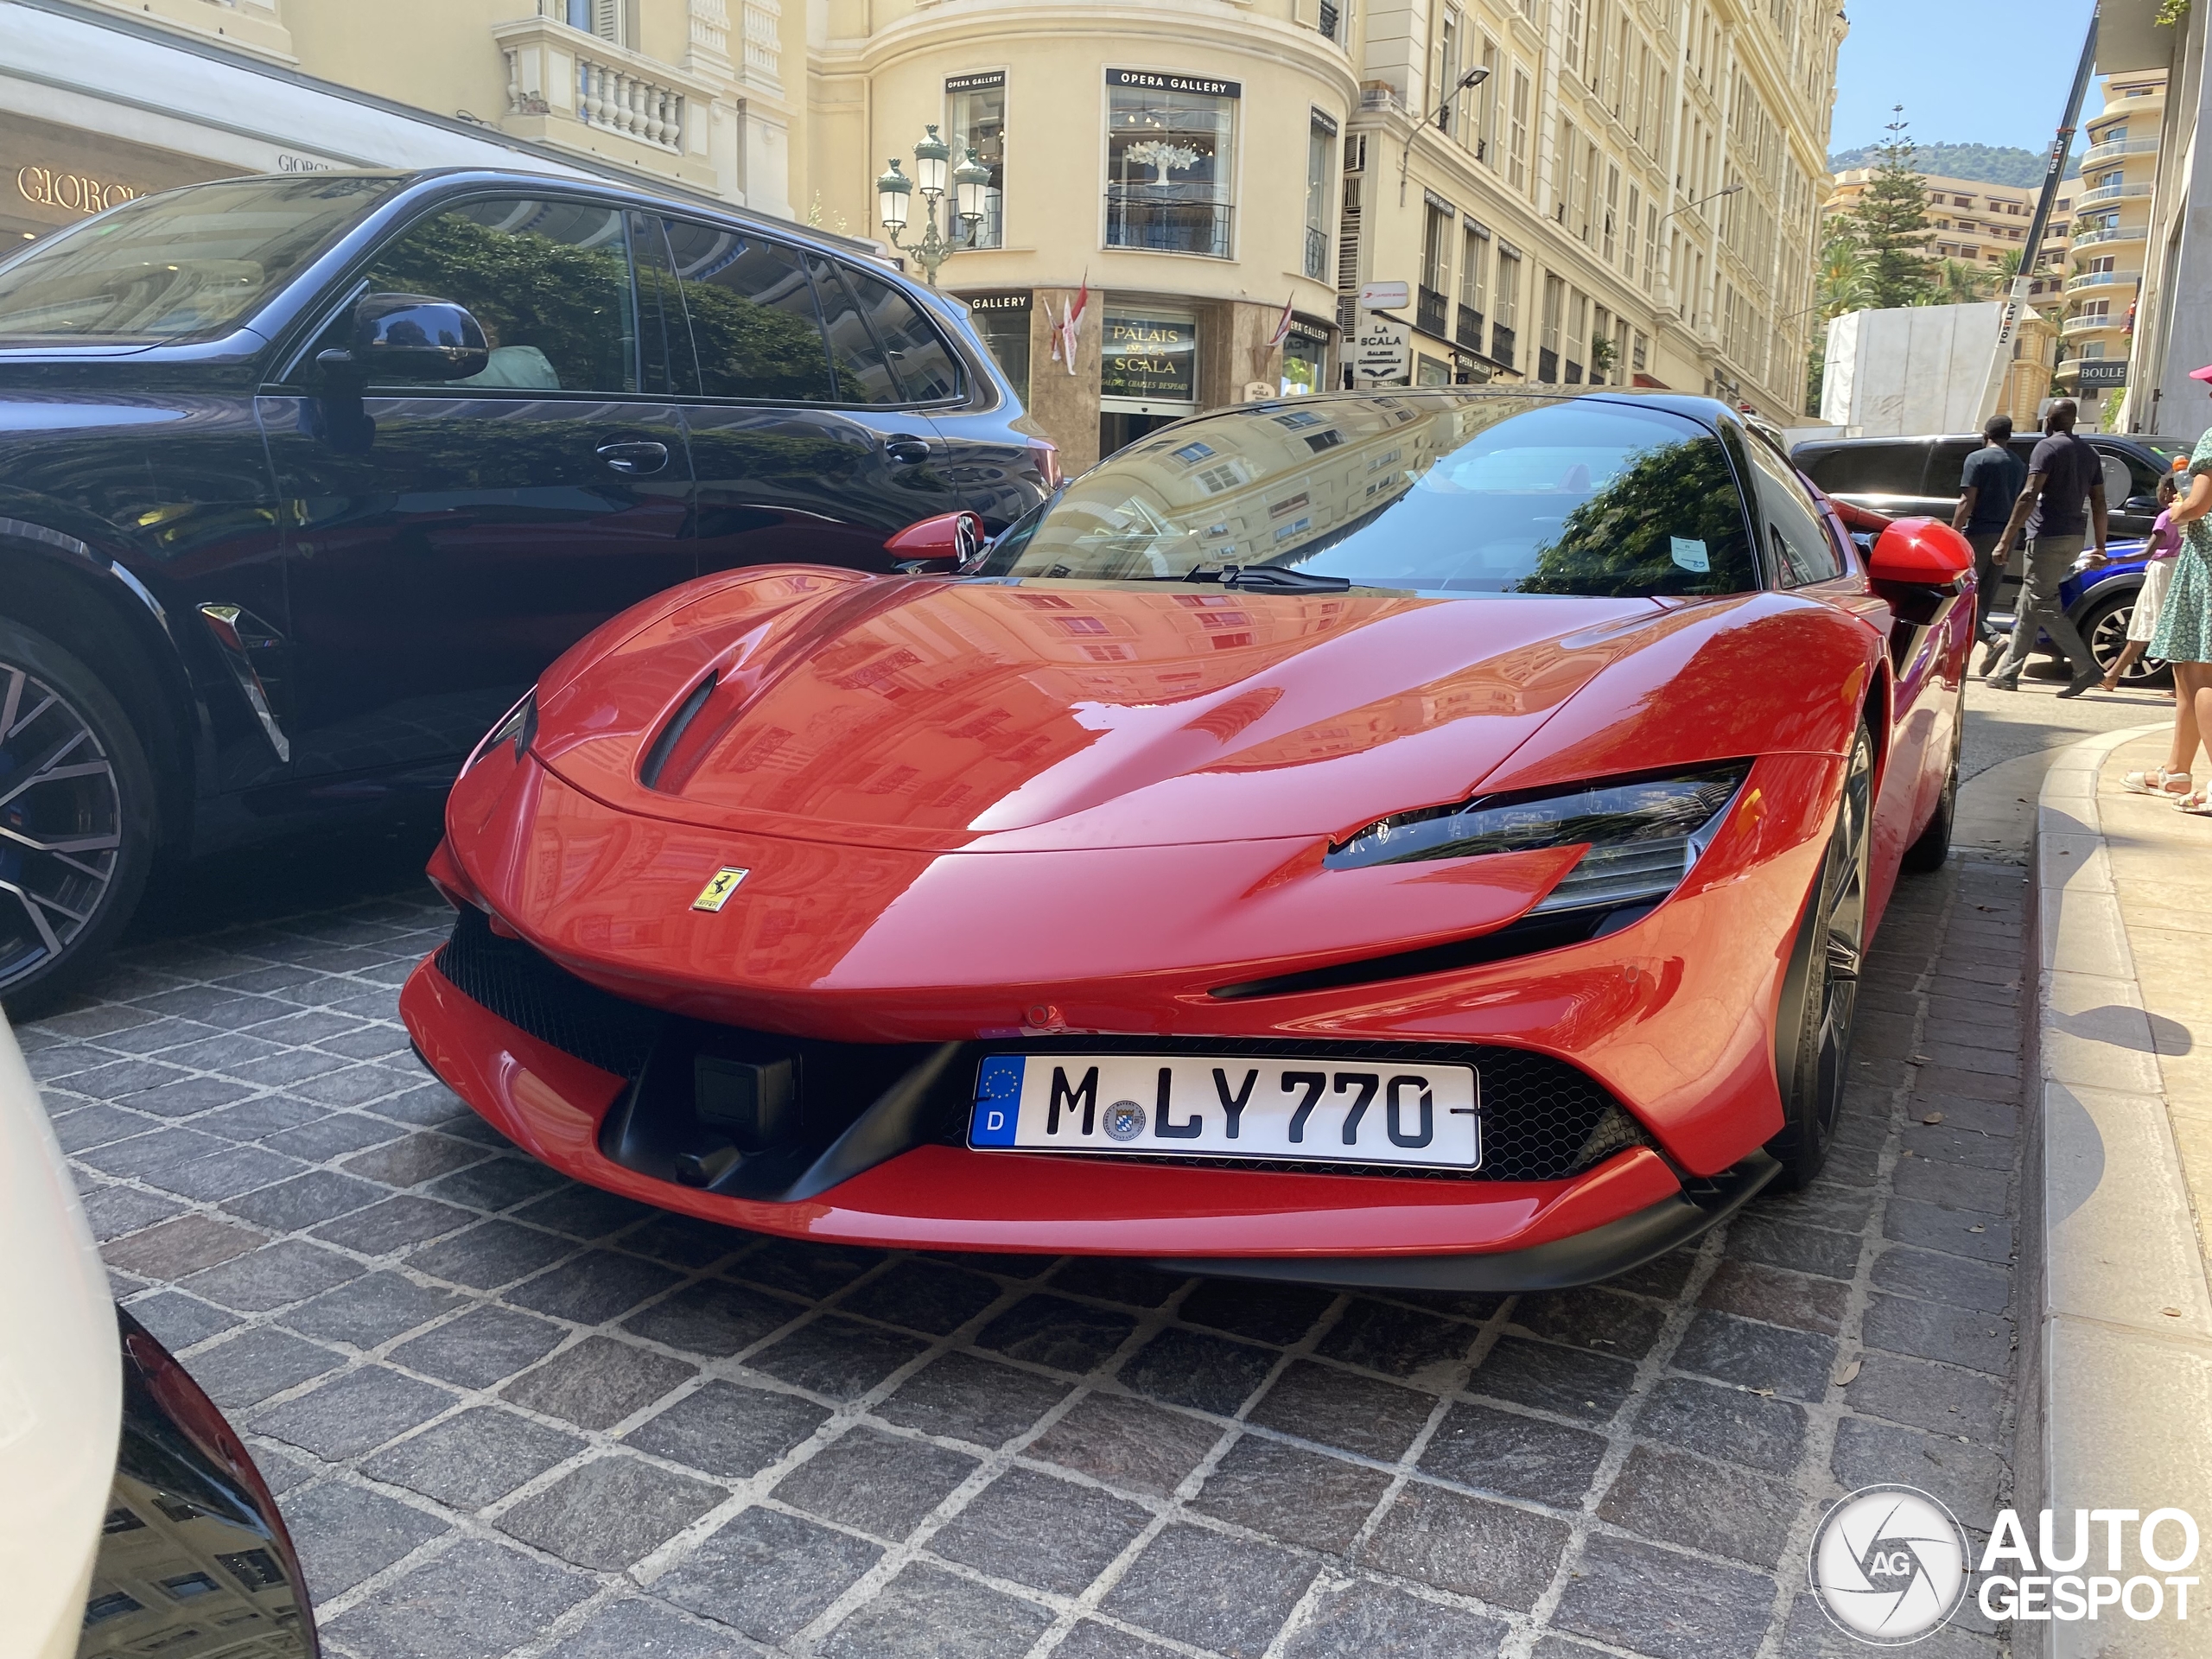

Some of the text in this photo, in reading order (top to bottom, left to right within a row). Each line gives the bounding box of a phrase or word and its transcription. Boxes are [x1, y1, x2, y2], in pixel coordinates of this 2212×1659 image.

[948, 75, 1002, 89] OPERA GALLERY
[1121, 73, 1227, 93] OPERA GALLERY
[972, 296, 1027, 309] GALLERY
[1374, 325, 1388, 334] LA
[1999, 302, 2017, 344] FOSELEV
[1113, 326, 1178, 343] PALAIS
[1303, 325, 1328, 341] GALLERY
[1360, 336, 1402, 346] SCALA
[1148, 346, 1166, 357] LA
[1114, 357, 1177, 374] SCALA
[1459, 354, 1491, 376] OPERA GALLERY
[2081, 367, 2126, 378] BOULE
[1128, 380, 1157, 389] CHARLES
[1046, 1066, 1434, 1149] M LY 770
[987, 1111, 1004, 1131] D
